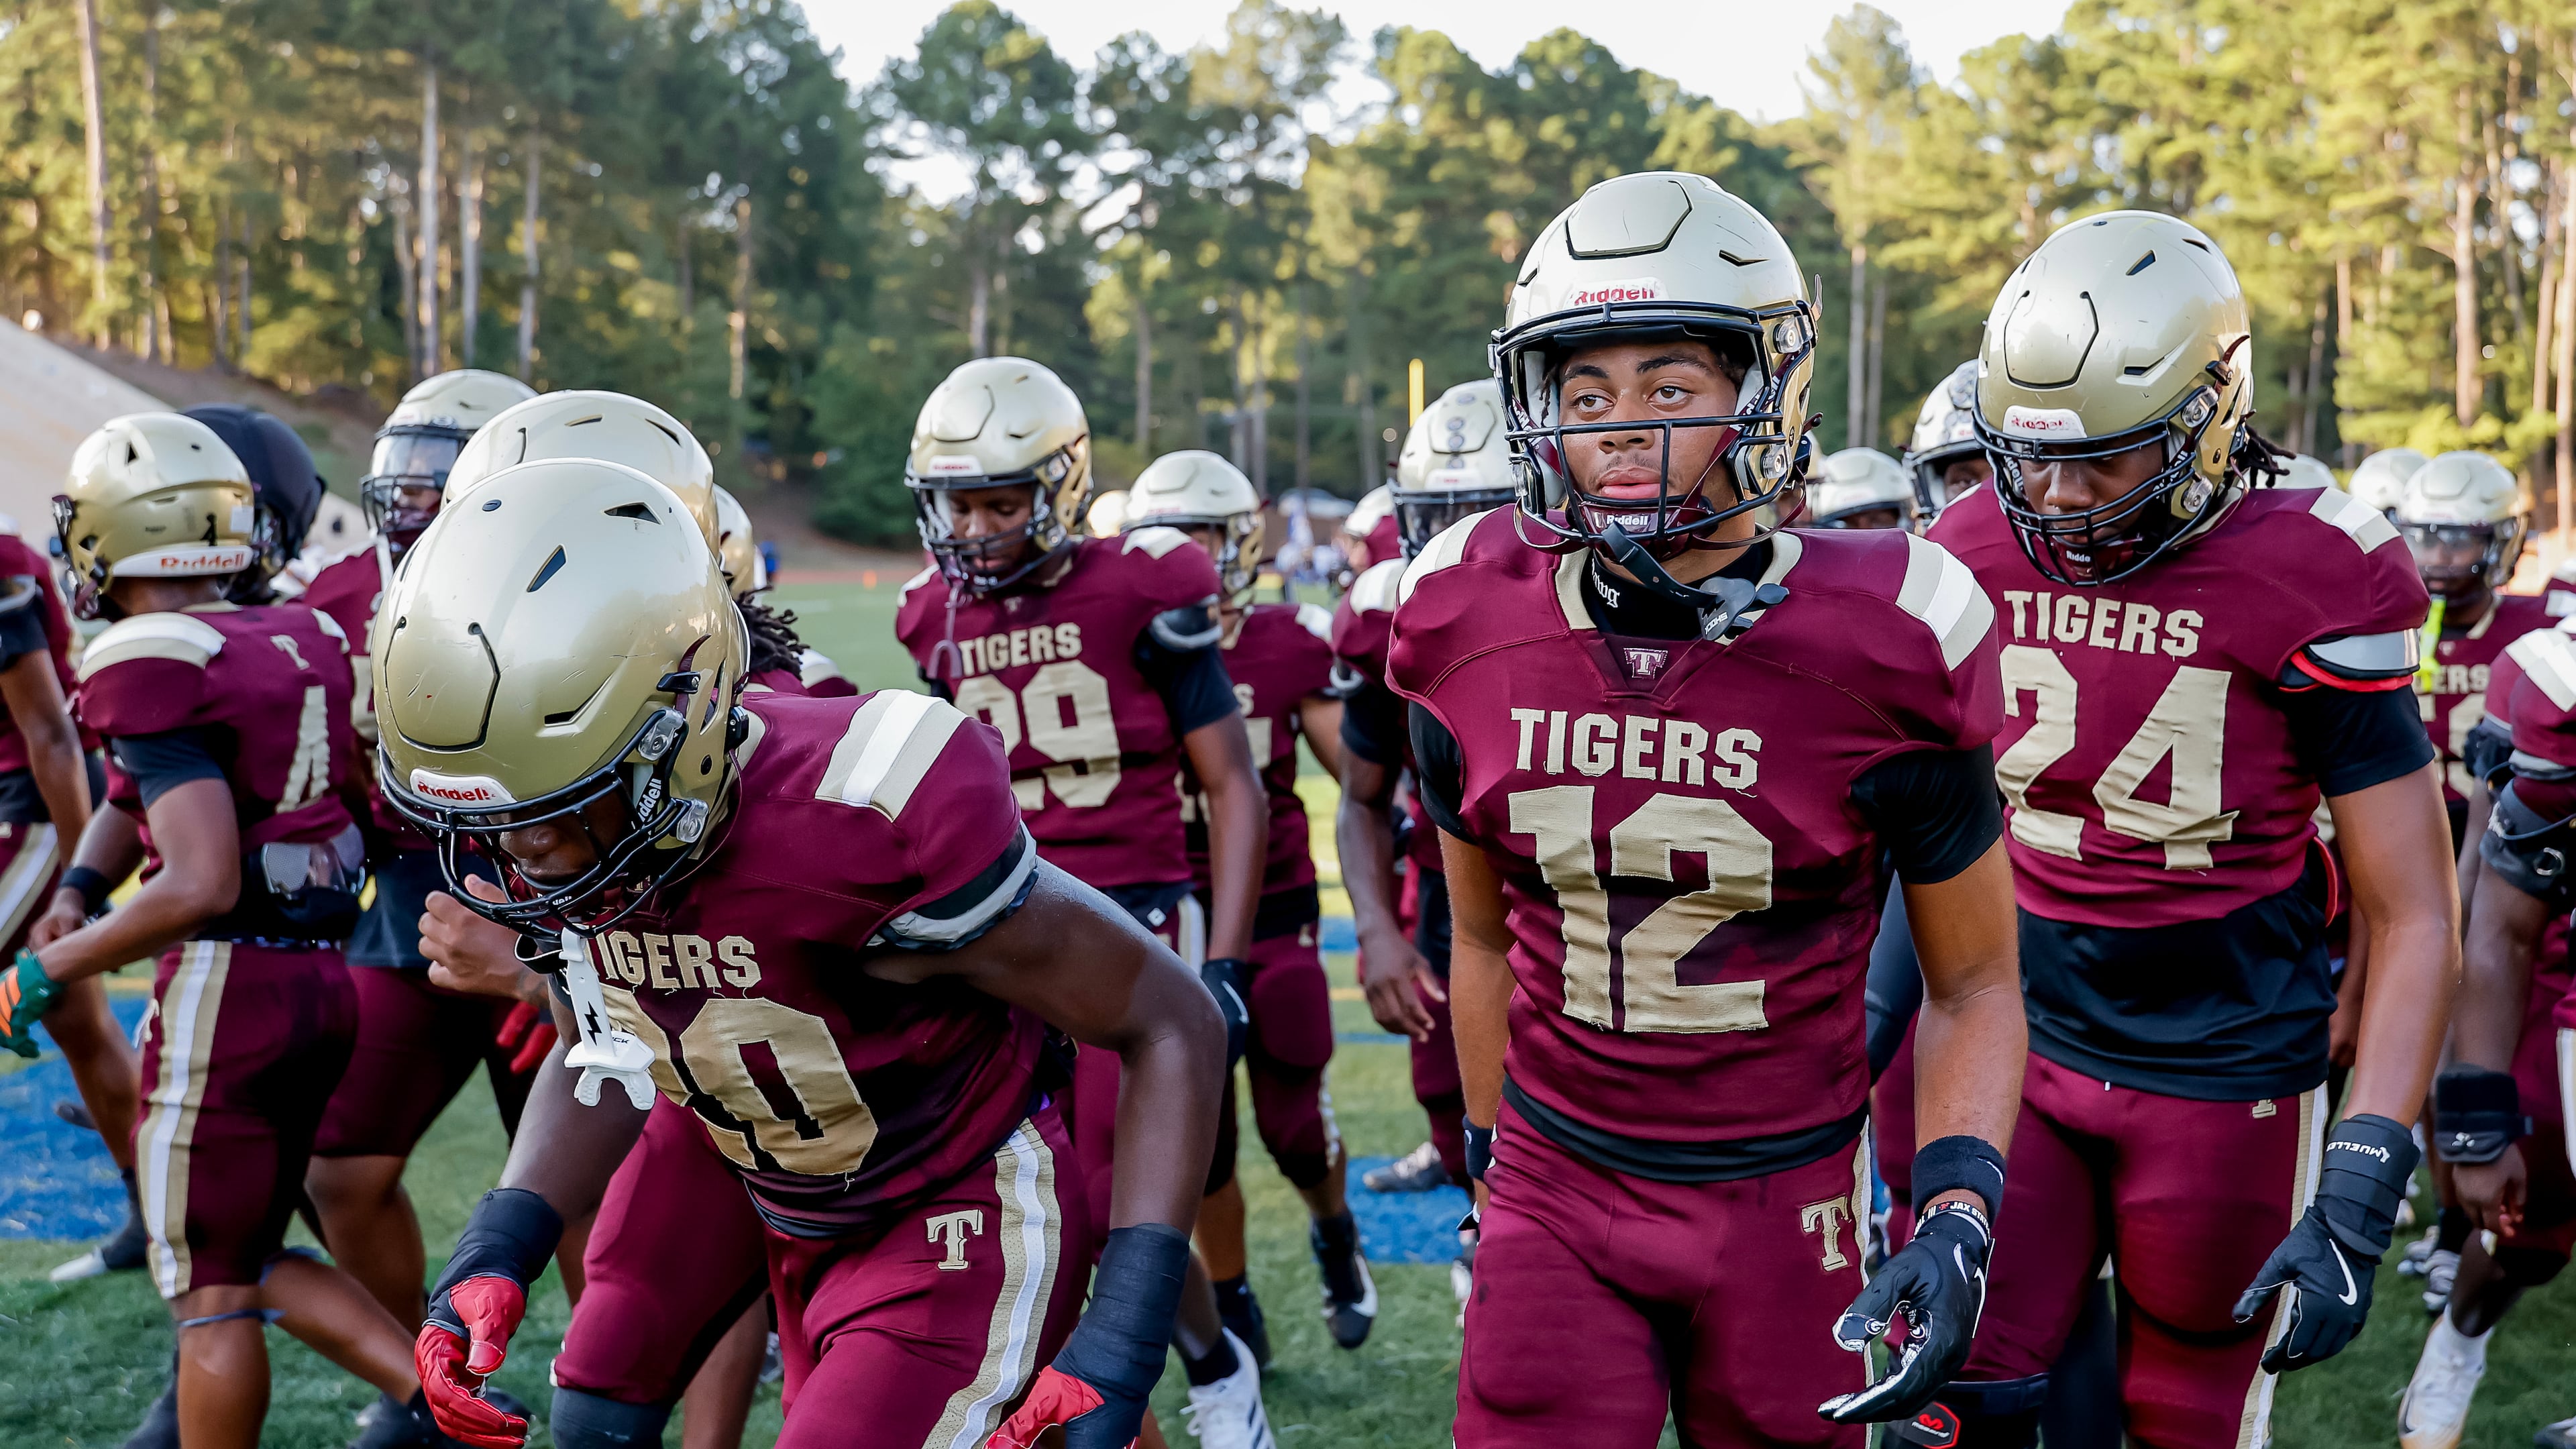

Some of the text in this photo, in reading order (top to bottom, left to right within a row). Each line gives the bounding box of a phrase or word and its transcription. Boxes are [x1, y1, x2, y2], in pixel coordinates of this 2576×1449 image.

[958, 622, 1083, 676] TIGERS
[2004, 590, 2204, 658] TIGERS
[1626, 649, 1665, 678] T
[1511, 708, 1763, 790] TIGERS
[1994, 643, 2241, 871] 24
[1508, 786, 1773, 1034] 12
[926, 1209, 983, 1271] T
[1801, 1194, 1849, 1271] T
[1949, 1201, 1971, 1213] JAX
